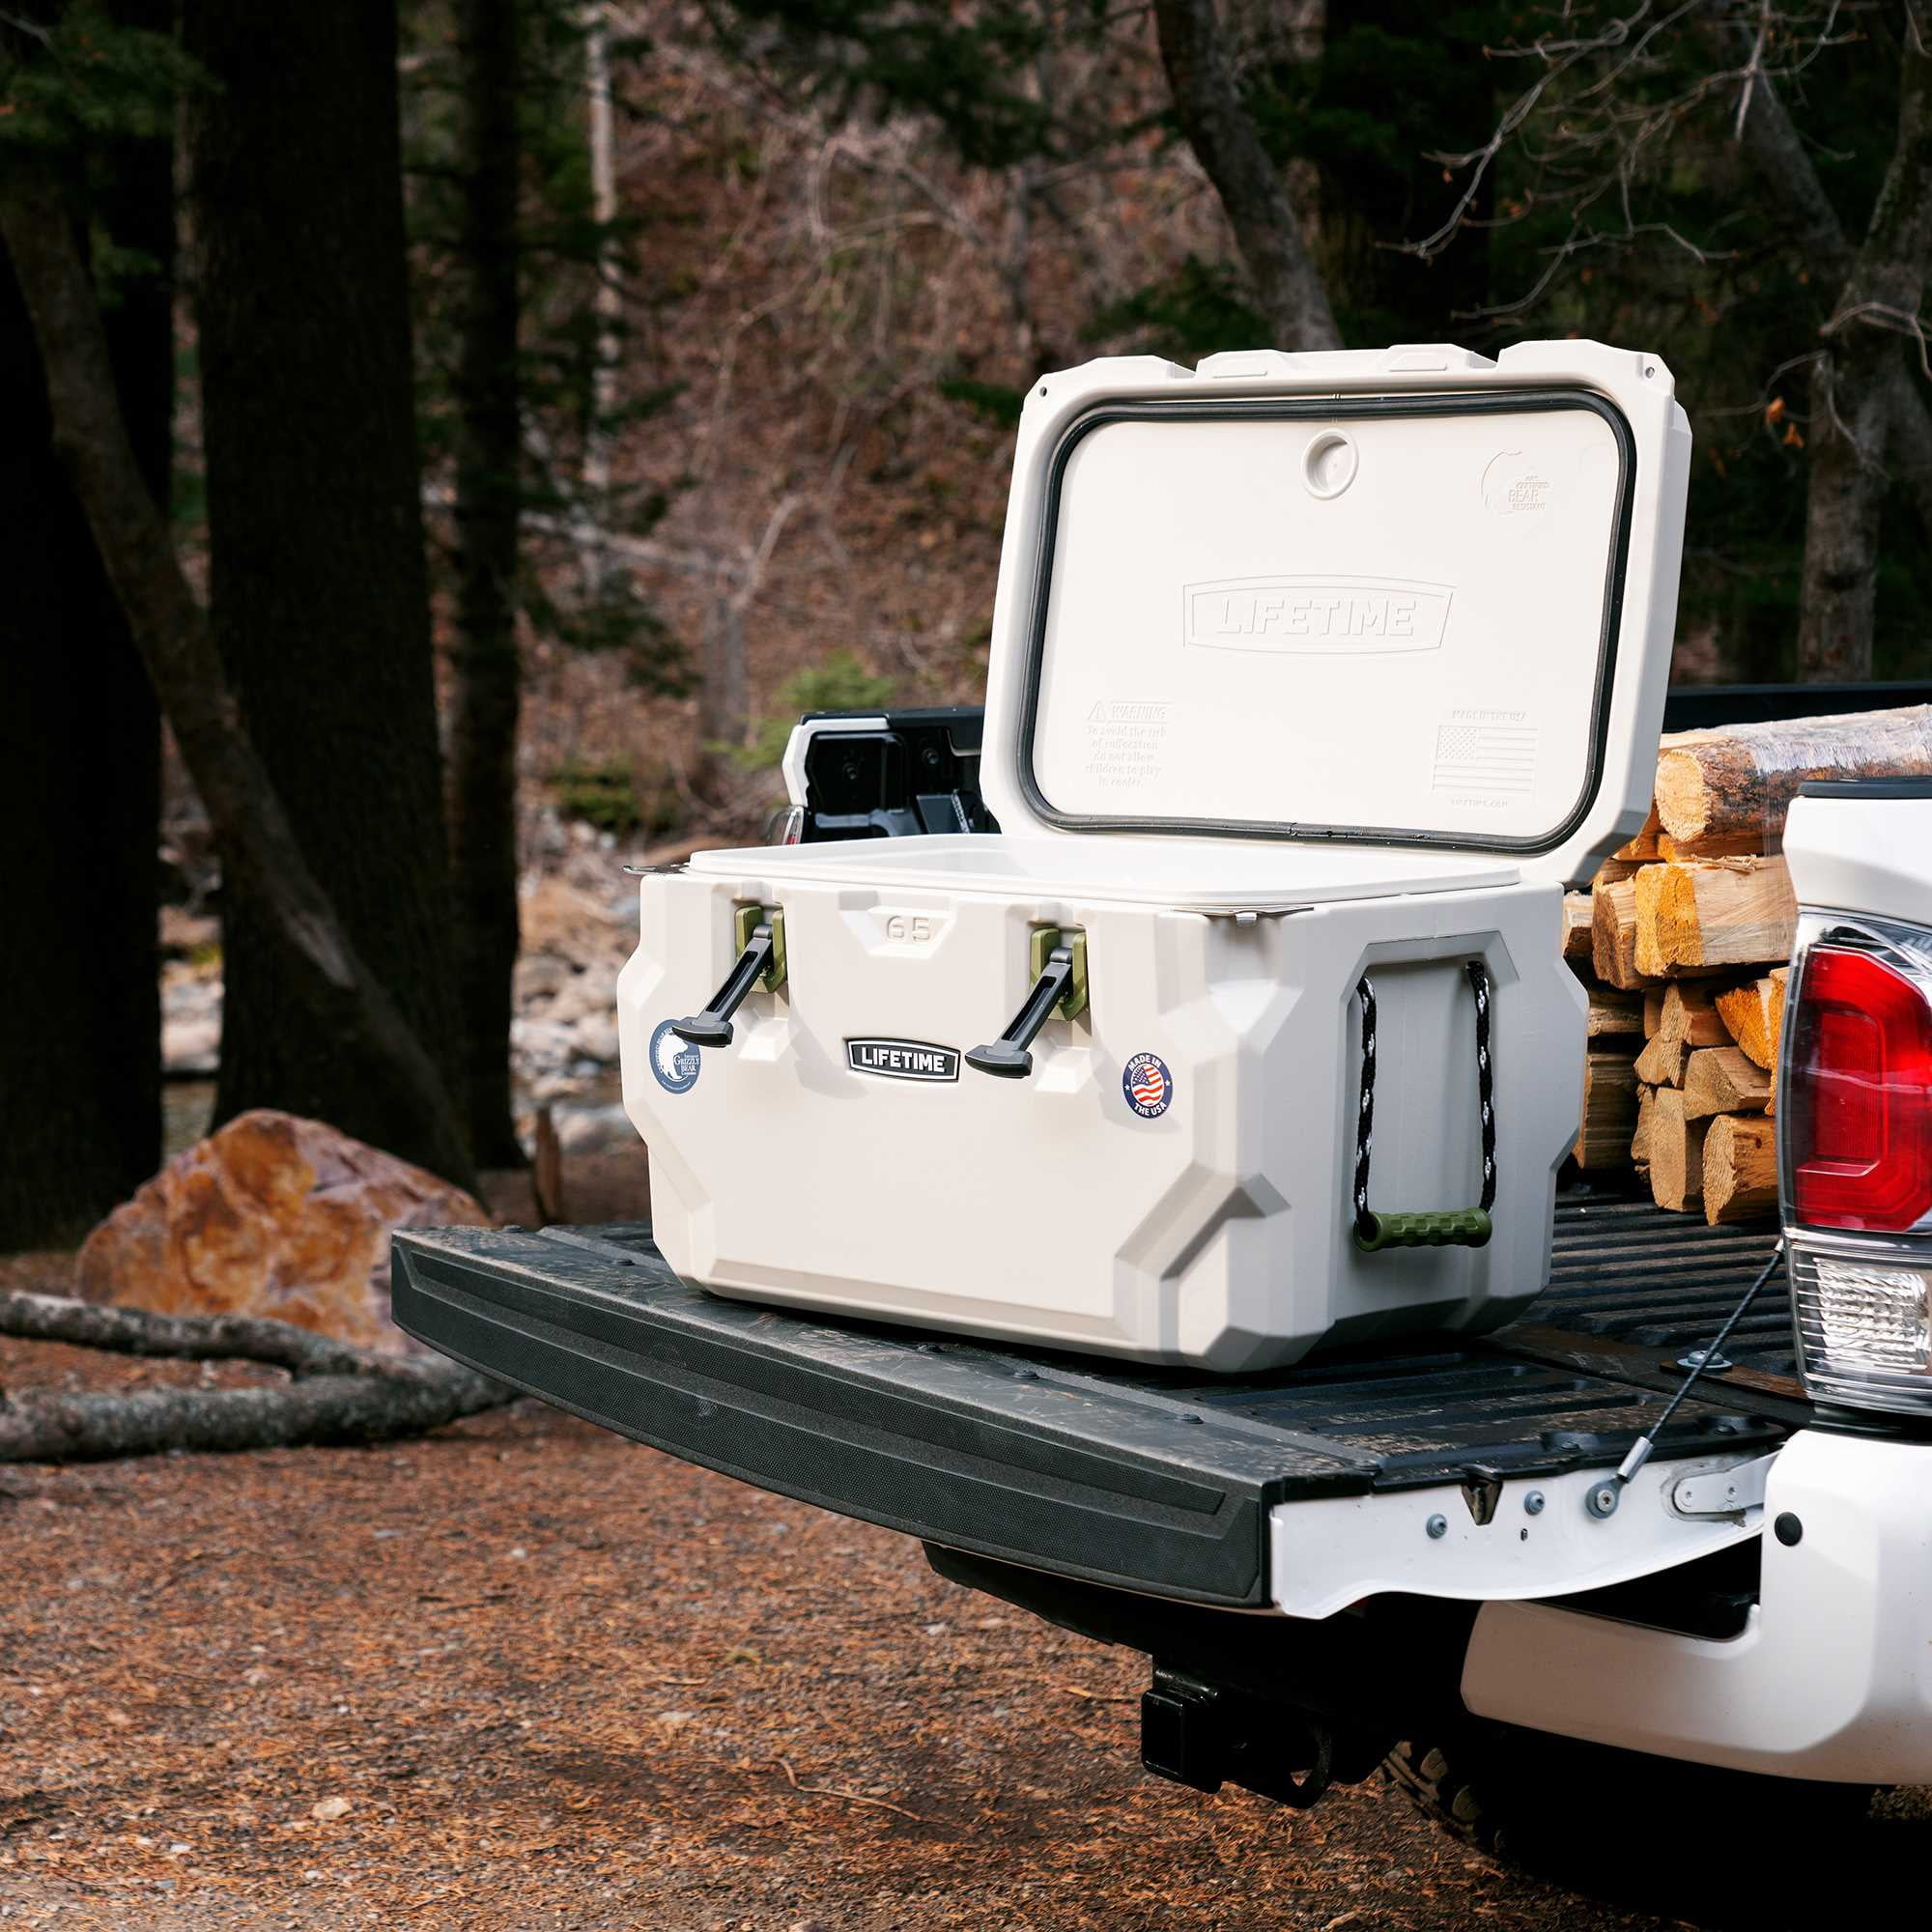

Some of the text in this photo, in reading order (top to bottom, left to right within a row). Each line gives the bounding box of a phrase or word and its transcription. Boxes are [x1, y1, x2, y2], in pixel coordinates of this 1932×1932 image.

[1509, 489, 1539, 503] BEAR
[1214, 597, 1417, 637] LIFETIME
[1112, 704, 1168, 720] WARNING
[886, 914, 932, 944] 65
[861, 1046, 946, 1073] LIFETIME
[1127, 1054, 1162, 1072] MADE IN
[1134, 1101, 1168, 1116] THE USA
